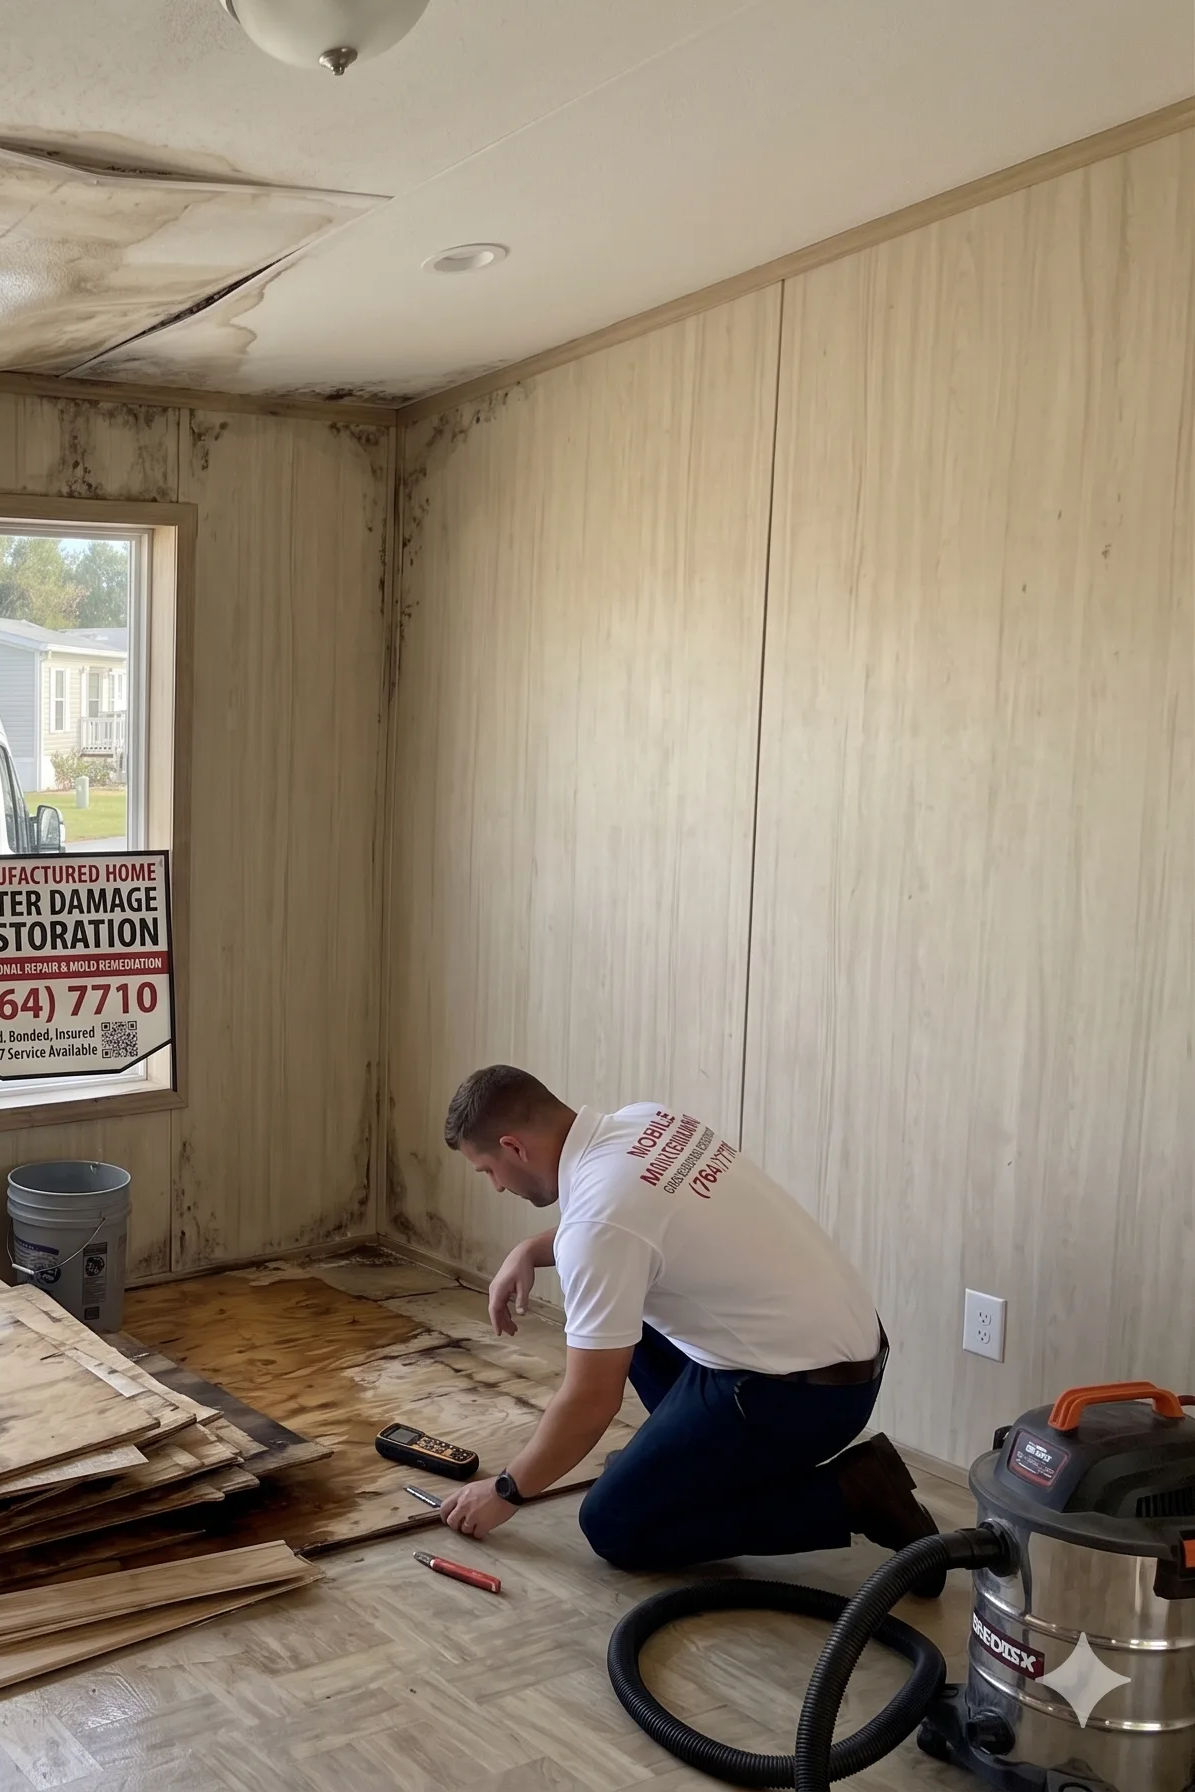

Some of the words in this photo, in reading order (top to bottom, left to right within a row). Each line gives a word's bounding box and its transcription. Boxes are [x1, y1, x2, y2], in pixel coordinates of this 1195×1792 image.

[106, 863, 157, 883] HOME
[49, 887, 158, 916] DAMAGE
[25, 962, 59, 974] REPAIR
[60, 961, 68, 972] &
[69, 960, 97, 972] MOLD
[99, 957, 162, 971] REMEDIATION
[68, 981, 158, 1016] 7710
[9, 1028, 53, 1043] Bonded,
[55, 1026, 95, 1041] Insured
[8, 1046, 46, 1060] Service
[48, 1044, 98, 1058] Available
